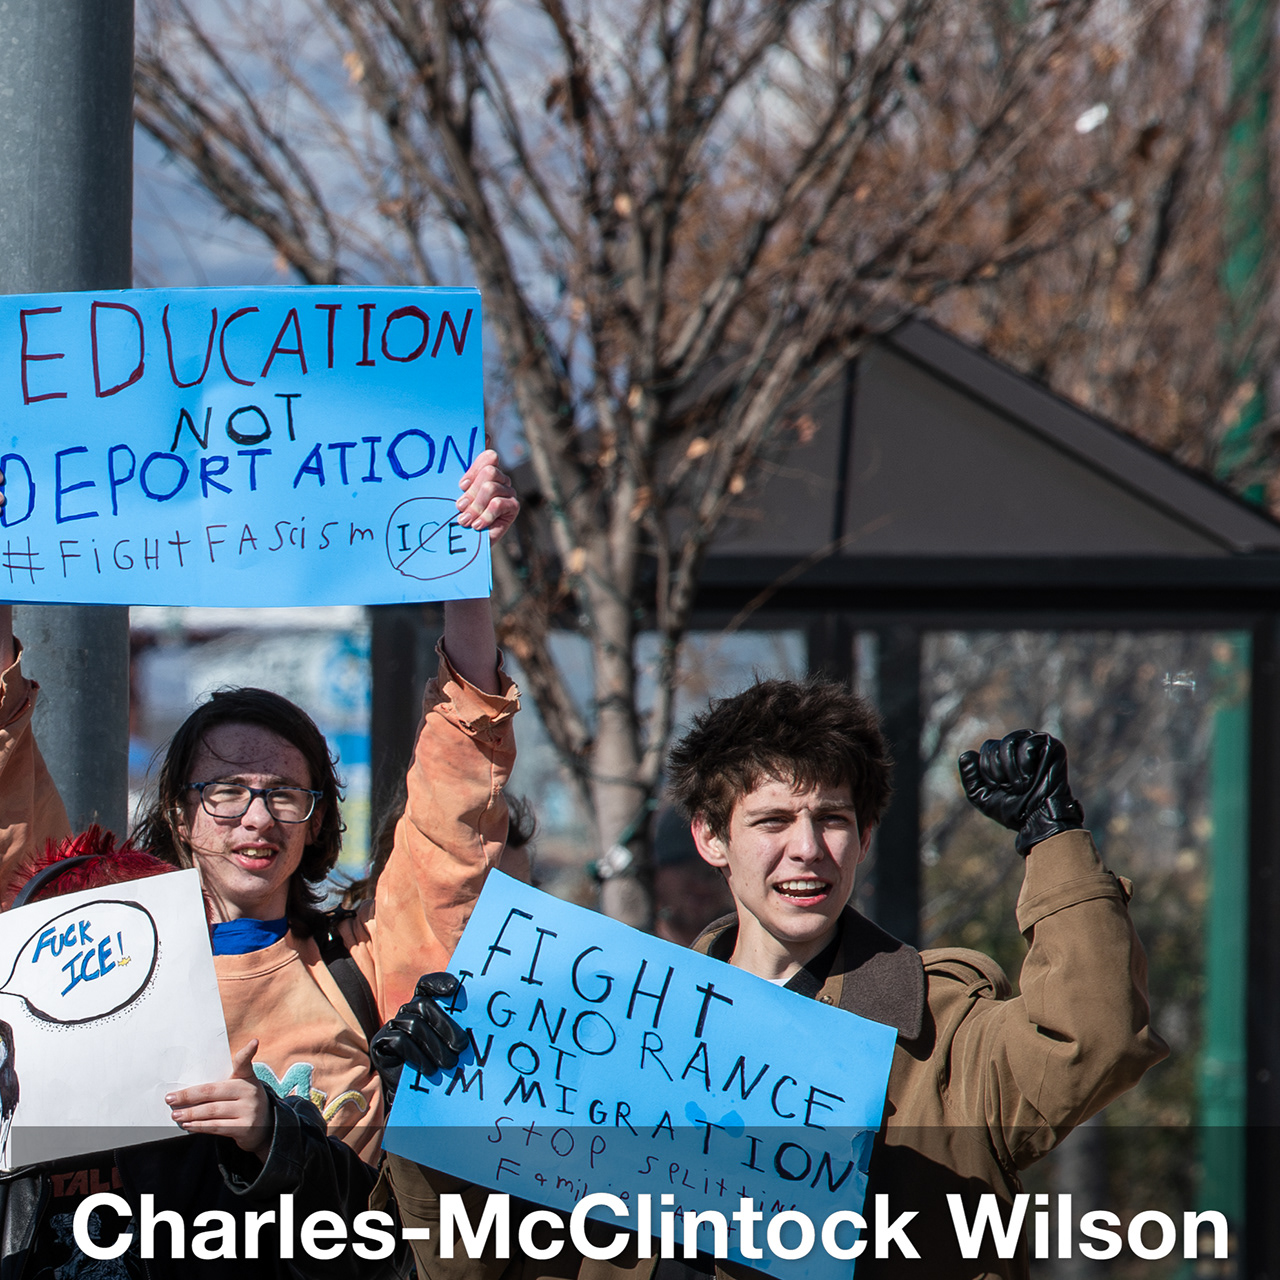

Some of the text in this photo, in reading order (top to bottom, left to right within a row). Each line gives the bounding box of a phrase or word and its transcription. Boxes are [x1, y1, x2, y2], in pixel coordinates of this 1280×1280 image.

[20, 300, 473, 405] EDUCATION
[171, 393, 302, 452] NOT
[31, 919, 94, 963] FUCK
[445, 970, 845, 1131] IGNORANCE
[409, 1066, 853, 1193] IMMIGRATION
